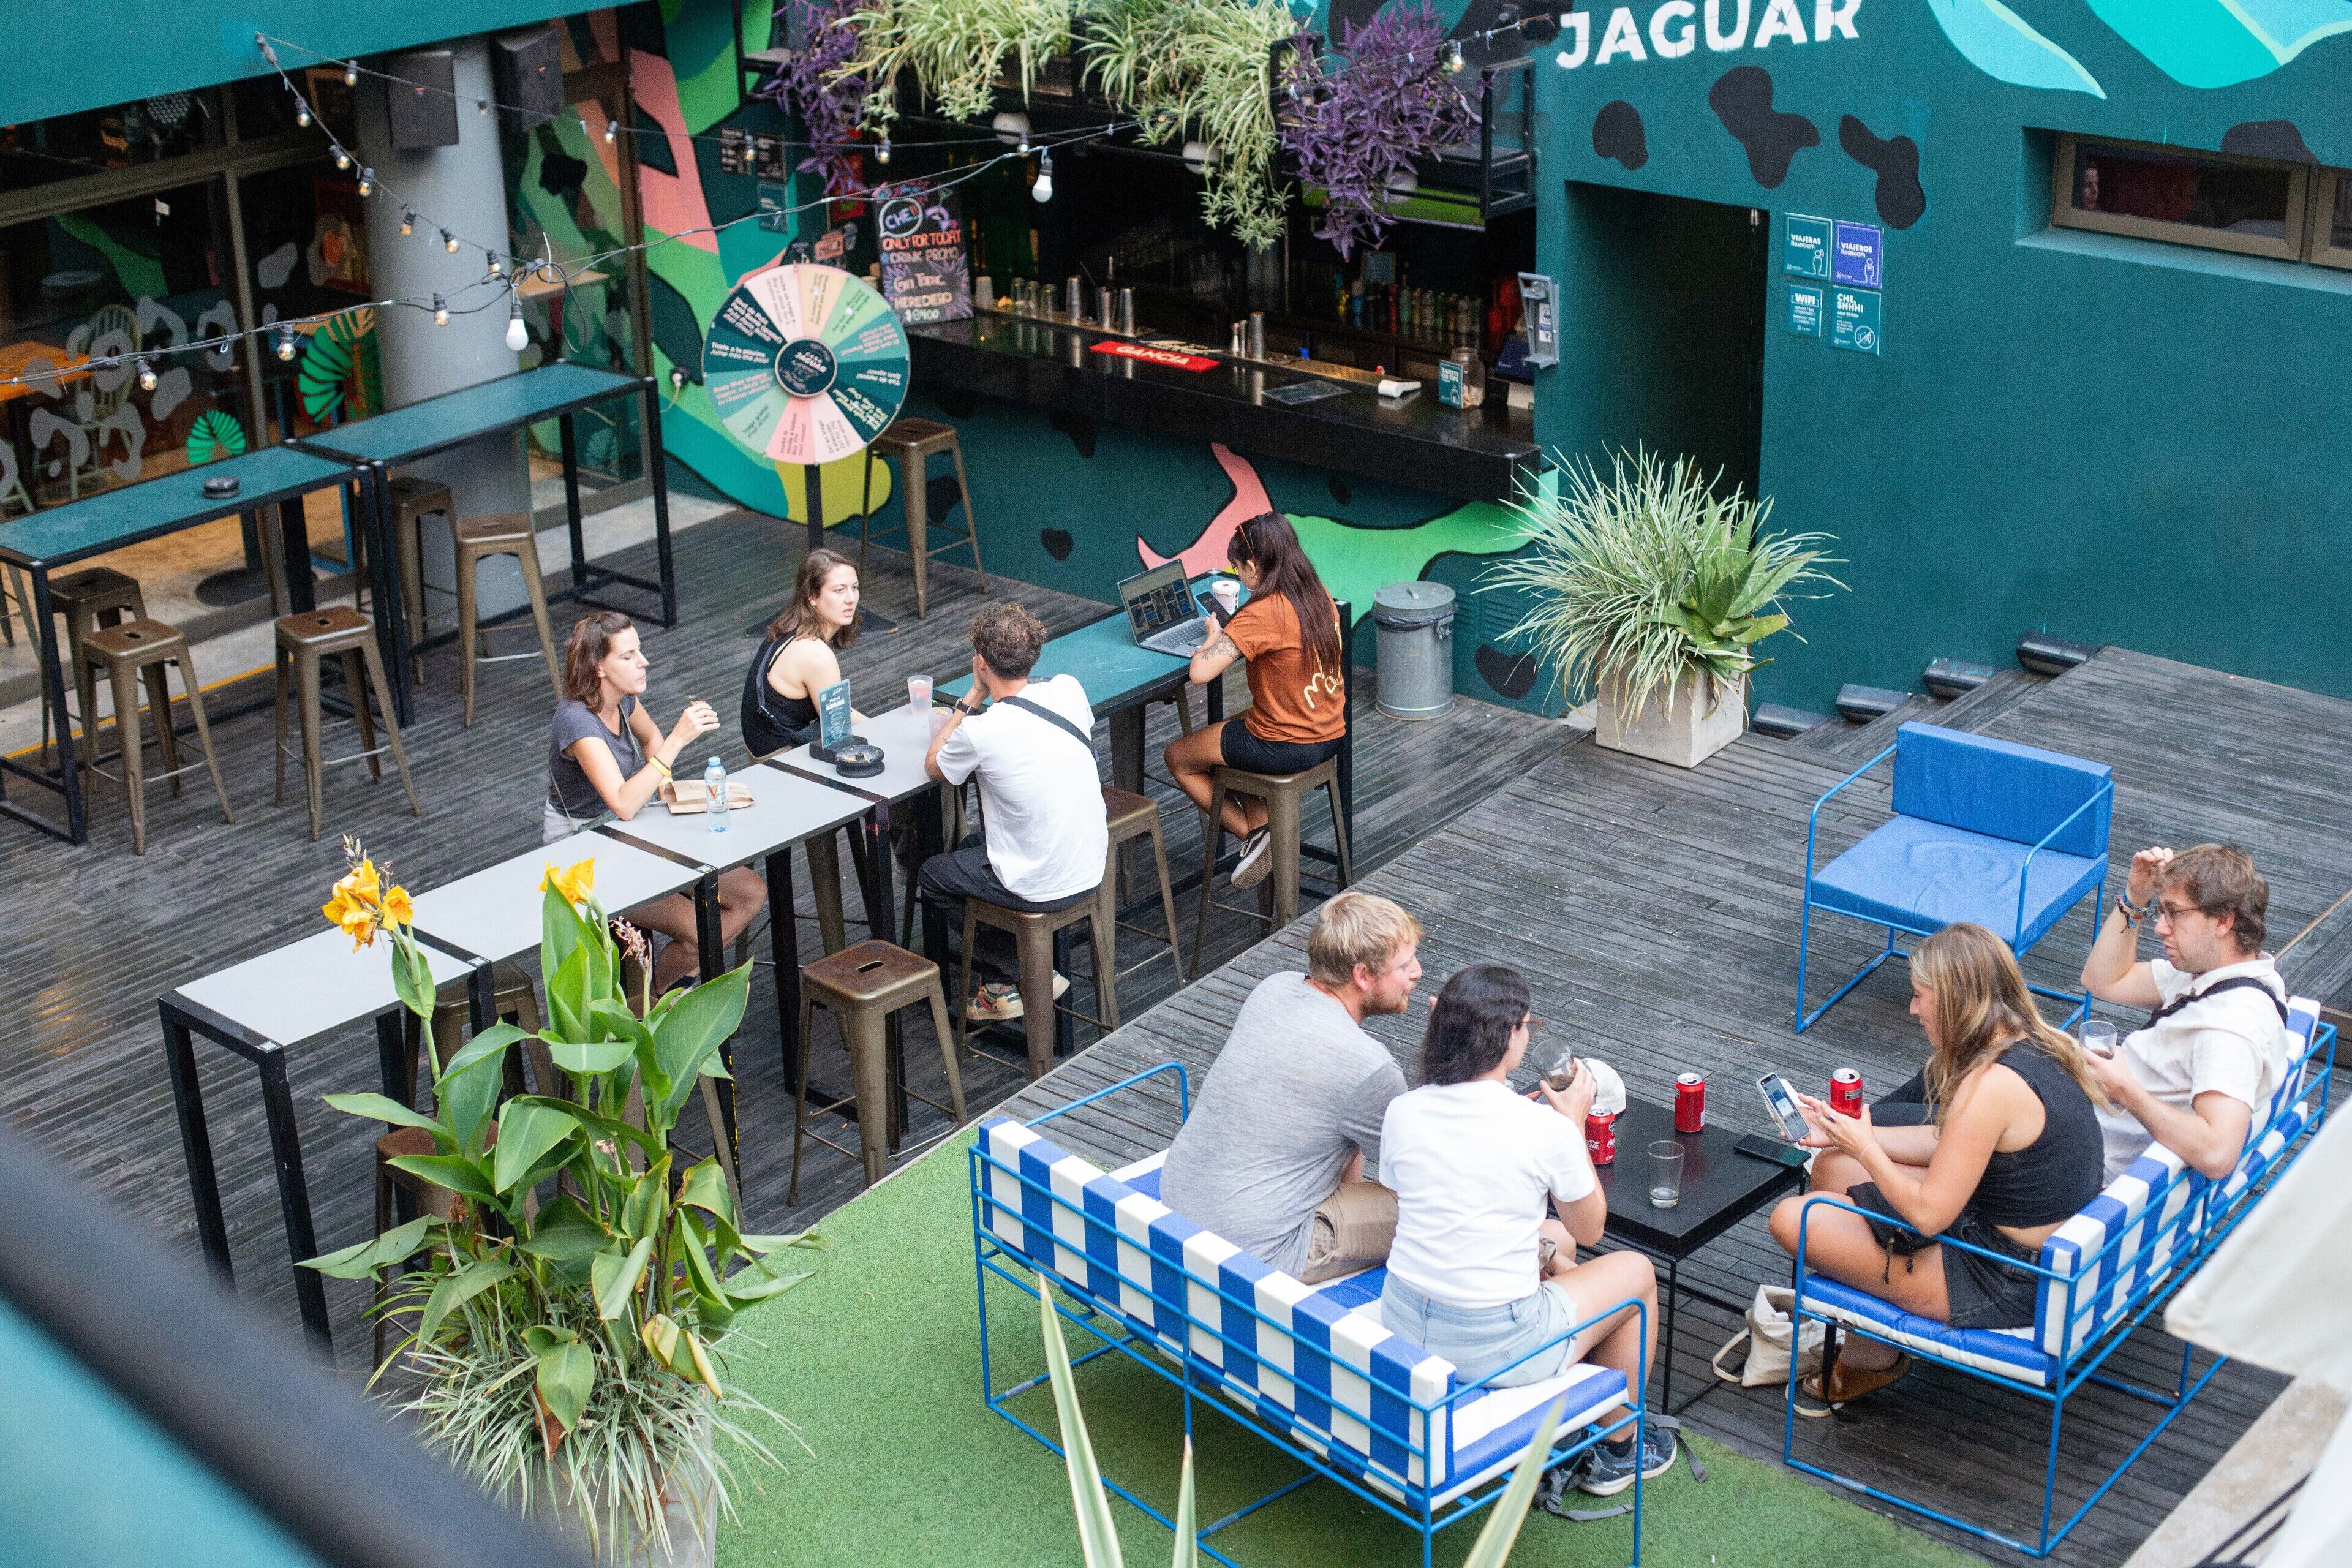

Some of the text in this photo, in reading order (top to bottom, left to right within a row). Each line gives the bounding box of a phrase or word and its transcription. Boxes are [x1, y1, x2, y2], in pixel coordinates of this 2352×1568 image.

[1556, 0, 1862, 69] JAGUAR
[882, 229, 961, 251] ONLY FOR TODAY
[1791, 233, 1821, 246] VIAJERAS
[1791, 240, 1815, 249] Restroom
[1841, 242, 1873, 254] VIAJEROS
[1841, 248, 1866, 258] Restroom
[889, 246, 959, 264] DRINK PROMO
[1795, 293, 1816, 306] WIFI
[1837, 293, 1856, 304] CHE,
[1116, 345, 1190, 365] GANCIA
[794, 350, 827, 374] JAGUAR
